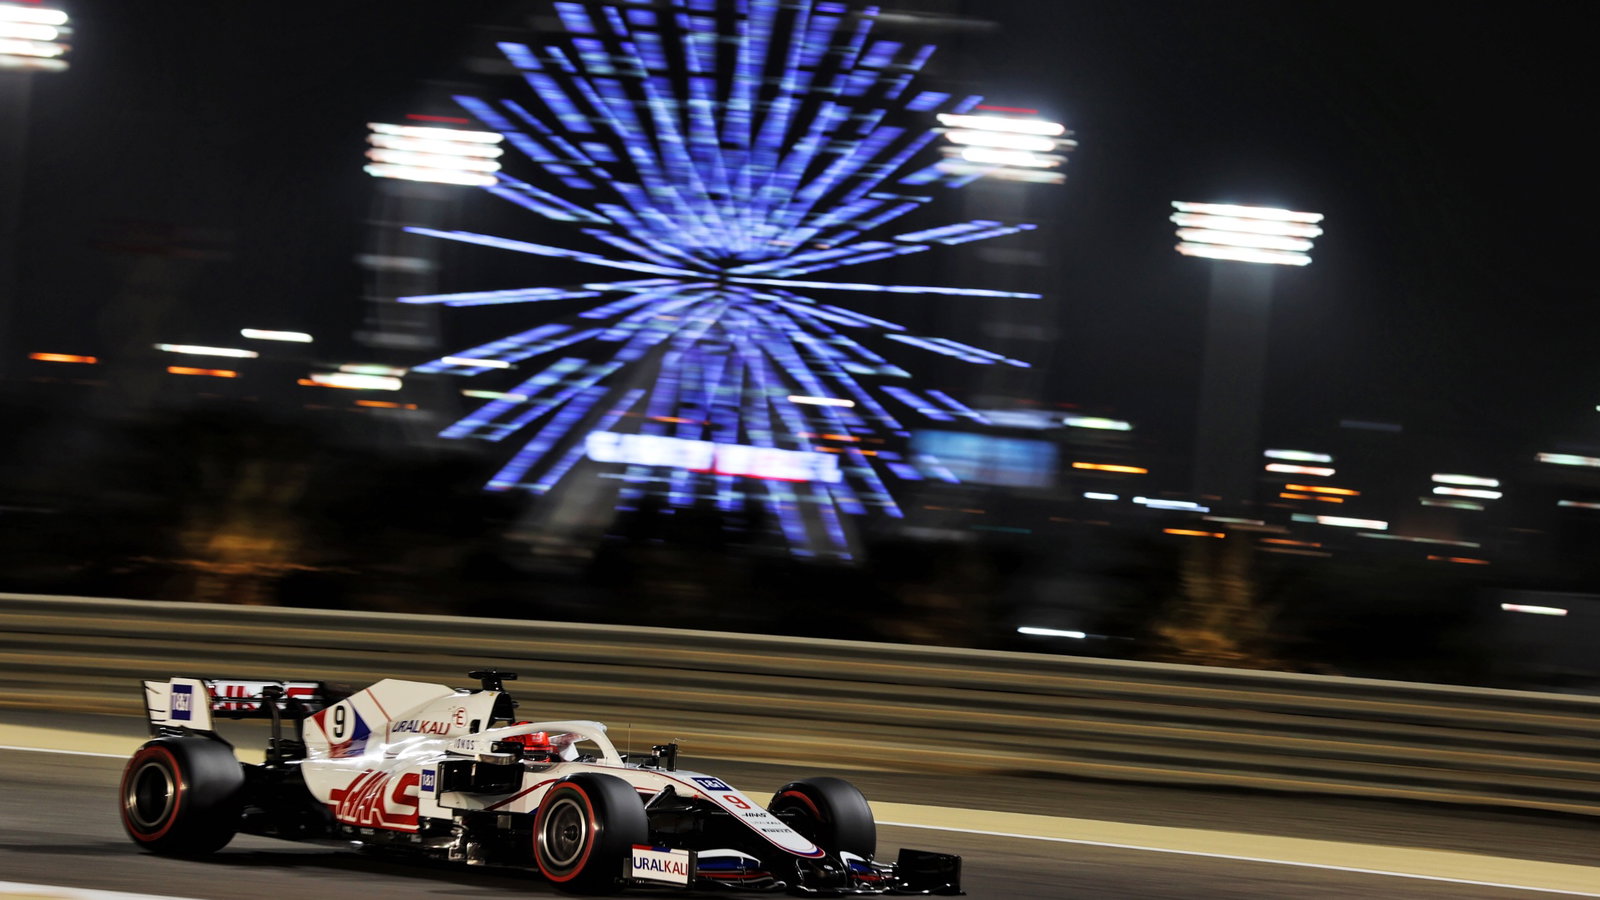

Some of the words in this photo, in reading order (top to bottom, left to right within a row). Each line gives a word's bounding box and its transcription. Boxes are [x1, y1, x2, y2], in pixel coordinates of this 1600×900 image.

[333, 705, 345, 738] 9
[392, 720, 451, 735] URALKALI
[697, 779, 725, 788] 1&1
[722, 795, 751, 809] 9
[633, 856, 688, 876] URALKALI
